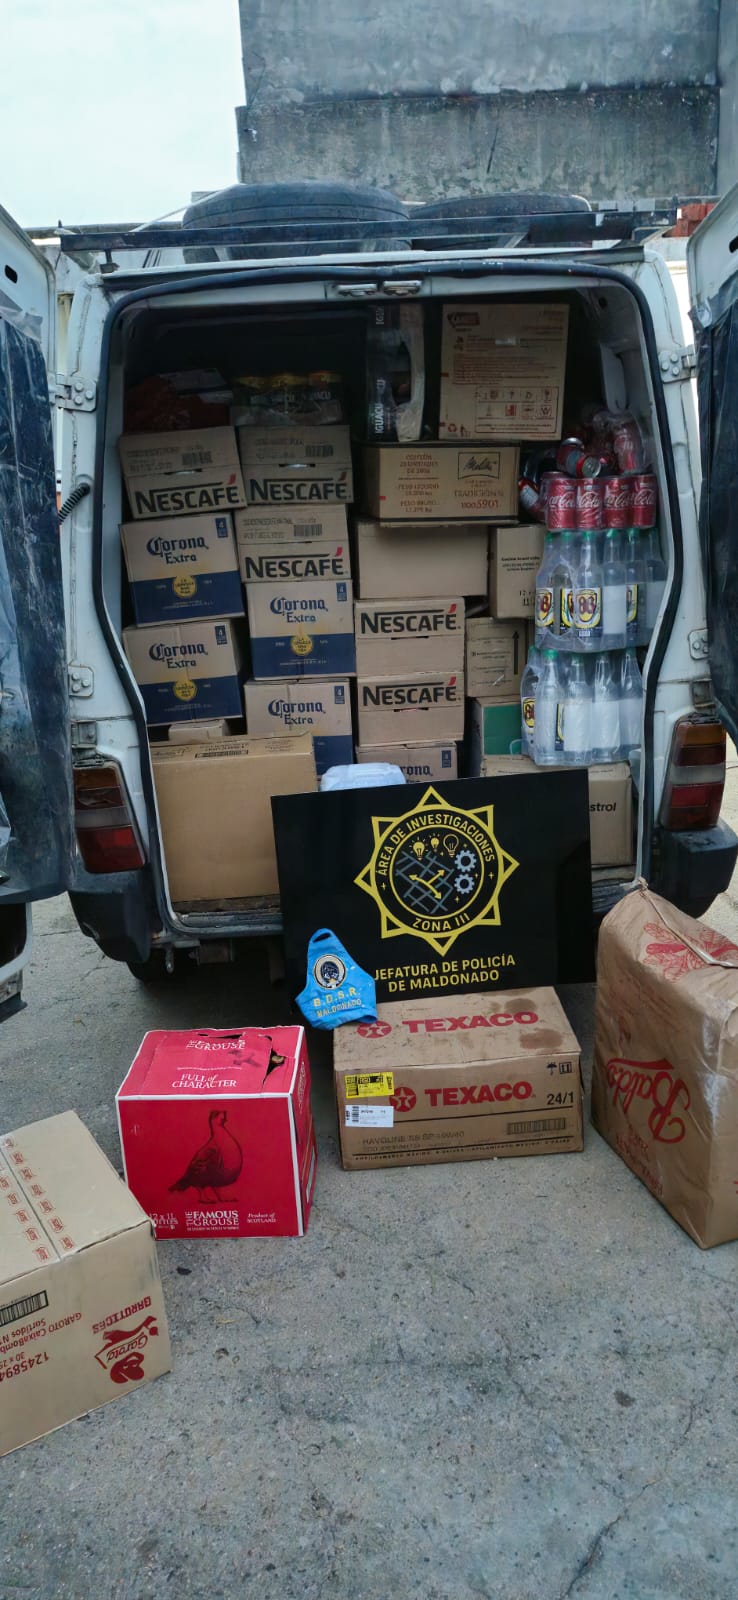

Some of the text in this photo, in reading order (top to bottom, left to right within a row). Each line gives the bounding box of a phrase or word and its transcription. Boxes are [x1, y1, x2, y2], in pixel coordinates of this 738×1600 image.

[135, 473, 240, 514] NESCAFÉ
[249, 471, 348, 501] NESCAFÉ
[146, 536, 209, 558] Corona
[165, 552, 197, 565] Extra
[245, 547, 344, 580] NESCAFÉ
[270, 597, 328, 617] Corona
[286, 612, 316, 624] Extra
[361, 603, 457, 634] NESCAFÉ
[149, 643, 208, 661] Corona
[167, 657, 197, 669] Extra
[363, 676, 457, 706] NESCAFÉ
[268, 699, 326, 718] Corona
[284, 711, 314, 725] Extra
[590, 802, 617, 812] strol
[390, 829, 406, 845] DE
[406, 813, 495, 863] INVESTIGACIONES
[412, 912, 471, 932] ZONA III
[375, 953, 516, 981] JEFATURA DE POLICÍA
[388, 970, 500, 993] DE MALDONADO
[402, 1011, 539, 1034] TEXACO
[194, 1040, 246, 1051] GROUSE
[172, 1079, 237, 1089] CHARACTER
[181, 1073, 207, 1082] FULL
[424, 1081, 533, 1107] TEXACO
[546, 1091, 575, 1106] 24/1
[193, 1210, 239, 1219] FAMOUS
[193, 1218, 239, 1226] GROUSE
[11, 1318, 46, 1338] Sortidos
[47, 1312, 82, 1333] GAROTO
